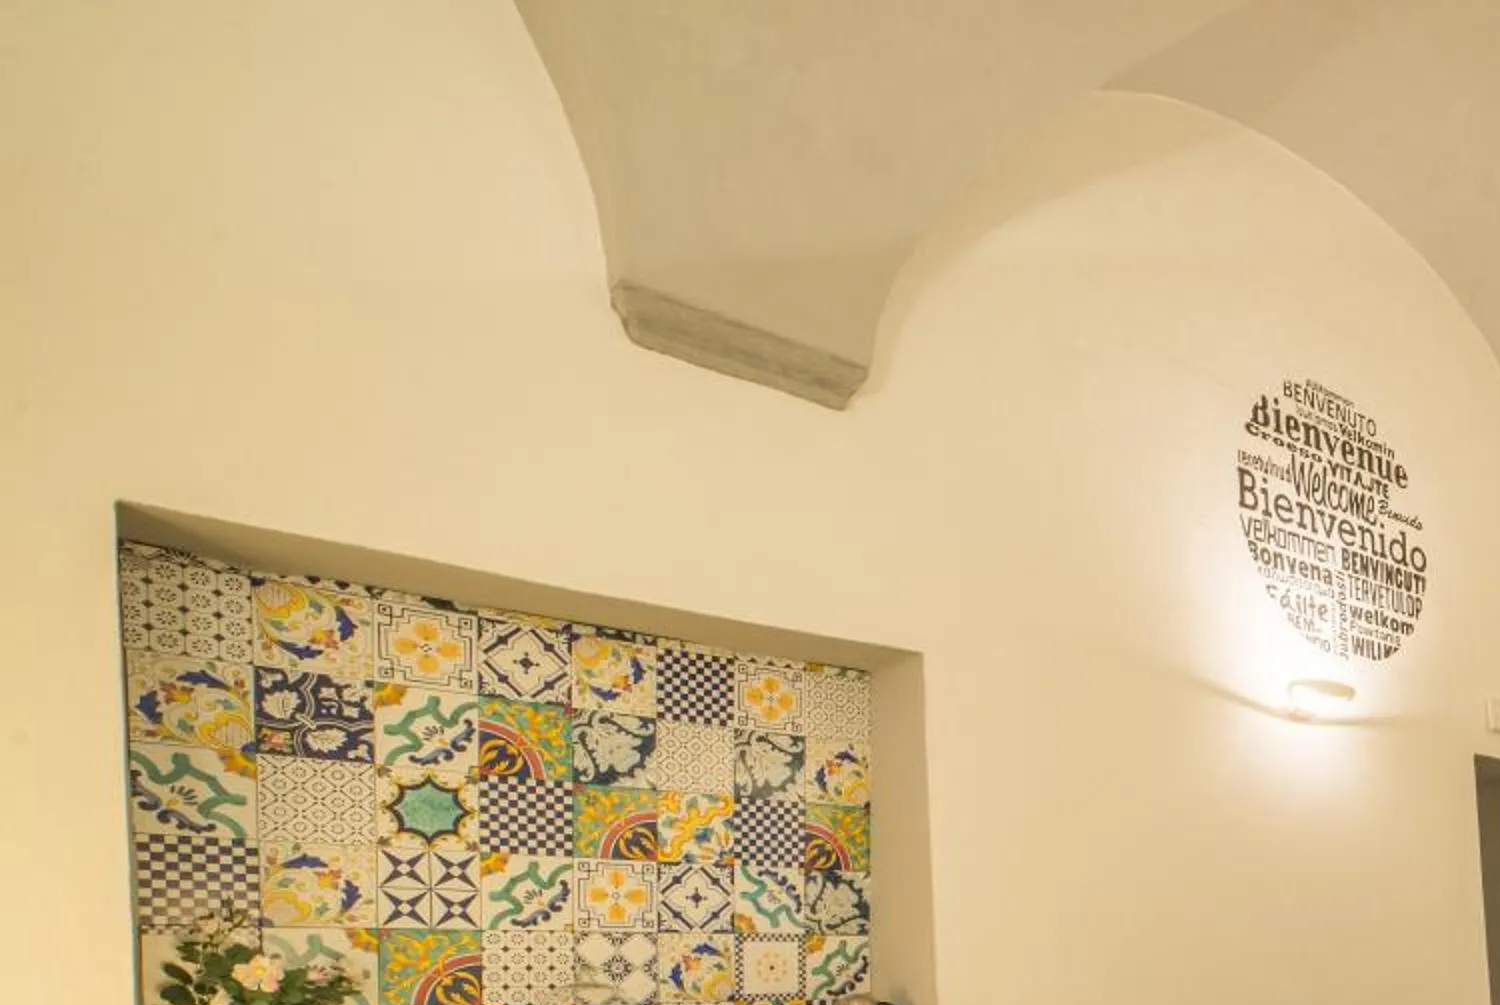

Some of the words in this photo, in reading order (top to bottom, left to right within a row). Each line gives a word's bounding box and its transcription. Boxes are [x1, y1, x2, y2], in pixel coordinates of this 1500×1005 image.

[1283, 380, 1377, 436] BENVENUTO
[1237, 466, 1427, 573] Bienvenido
[1291, 452, 1377, 525] Welcome
[1350, 603, 1415, 636] welkom
